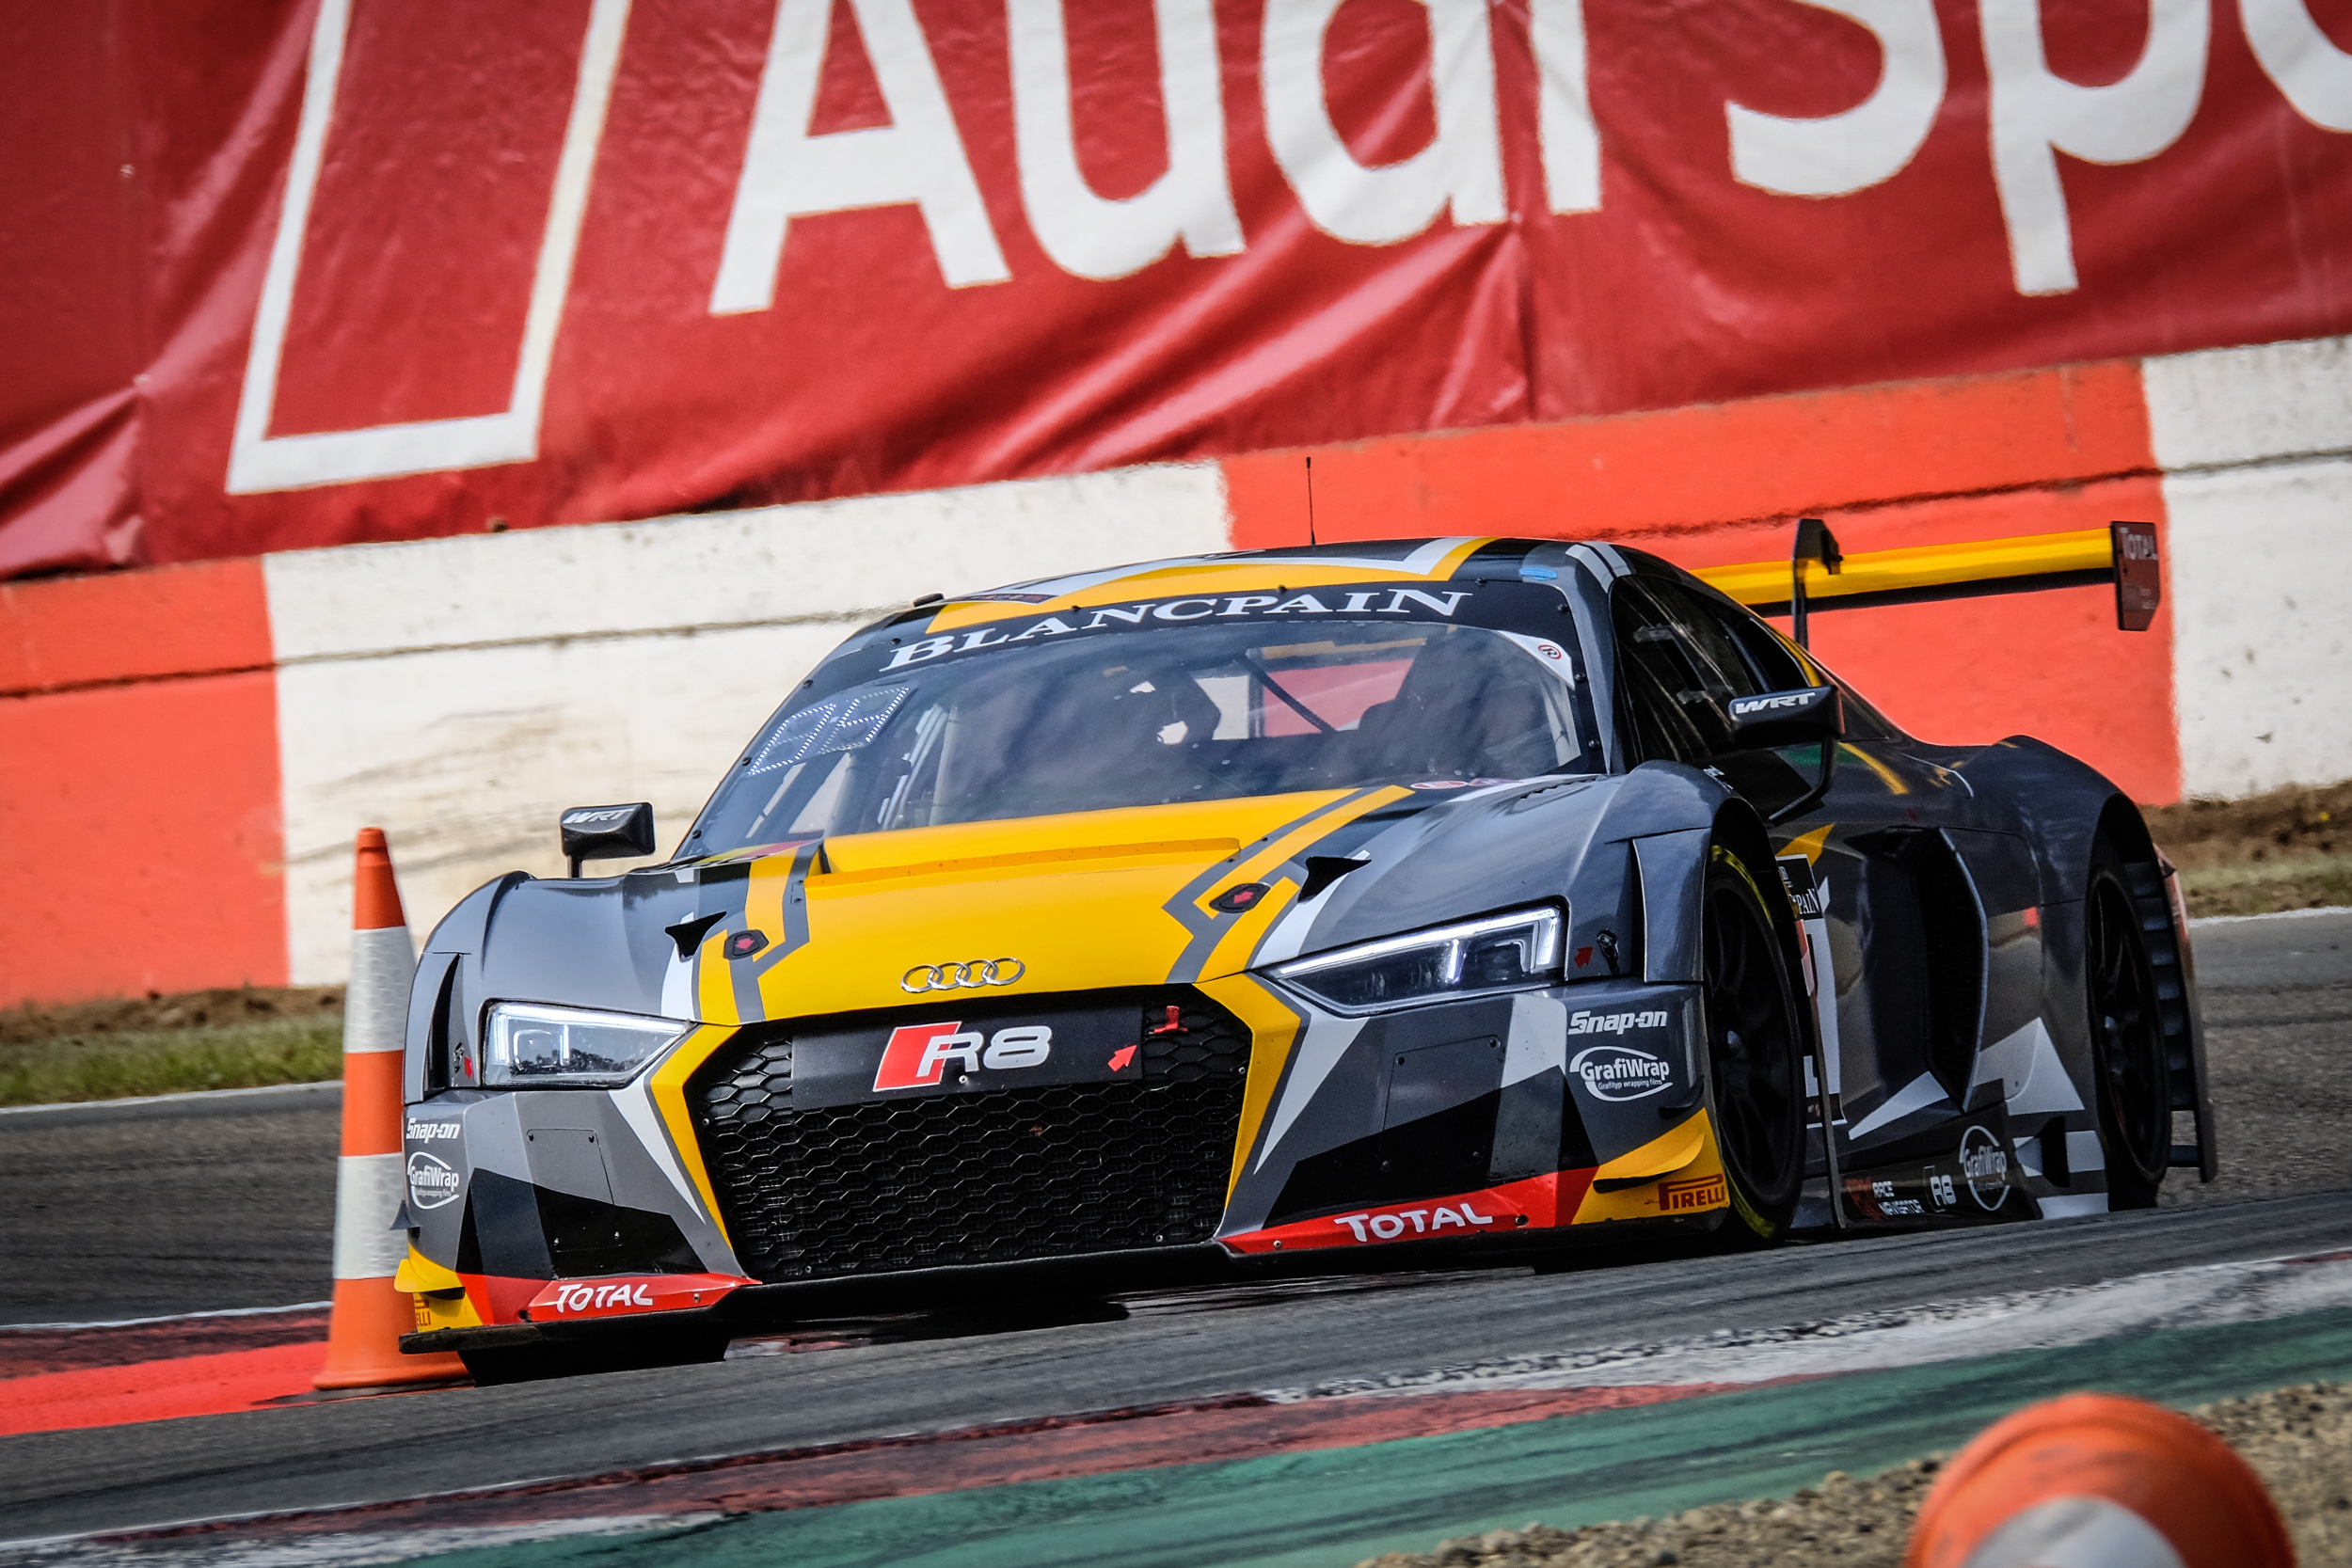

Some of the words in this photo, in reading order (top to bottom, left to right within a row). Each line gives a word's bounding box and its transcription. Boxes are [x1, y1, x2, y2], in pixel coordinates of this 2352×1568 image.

[708, 0, 1603, 317] Audi
[2120, 527, 2158, 560] TOTAL
[878, 588, 1472, 672] BLANCPAIN
[1735, 691, 1816, 715] WRT
[563, 808, 637, 824] WRT
[1567, 1010, 1668, 1036] Snap-on
[916, 1025, 1053, 1079] R8
[1581, 1057, 1670, 1081] GrafiWrap
[405, 1117, 461, 1144] Snap-on
[409, 1165, 459, 1193] GrafiWrap
[1658, 1173, 1726, 1212] PIRELLI
[1930, 1174, 1958, 1207] R8
[1334, 1203, 1494, 1243] TOTAL
[555, 1283, 654, 1314] TOTAL
